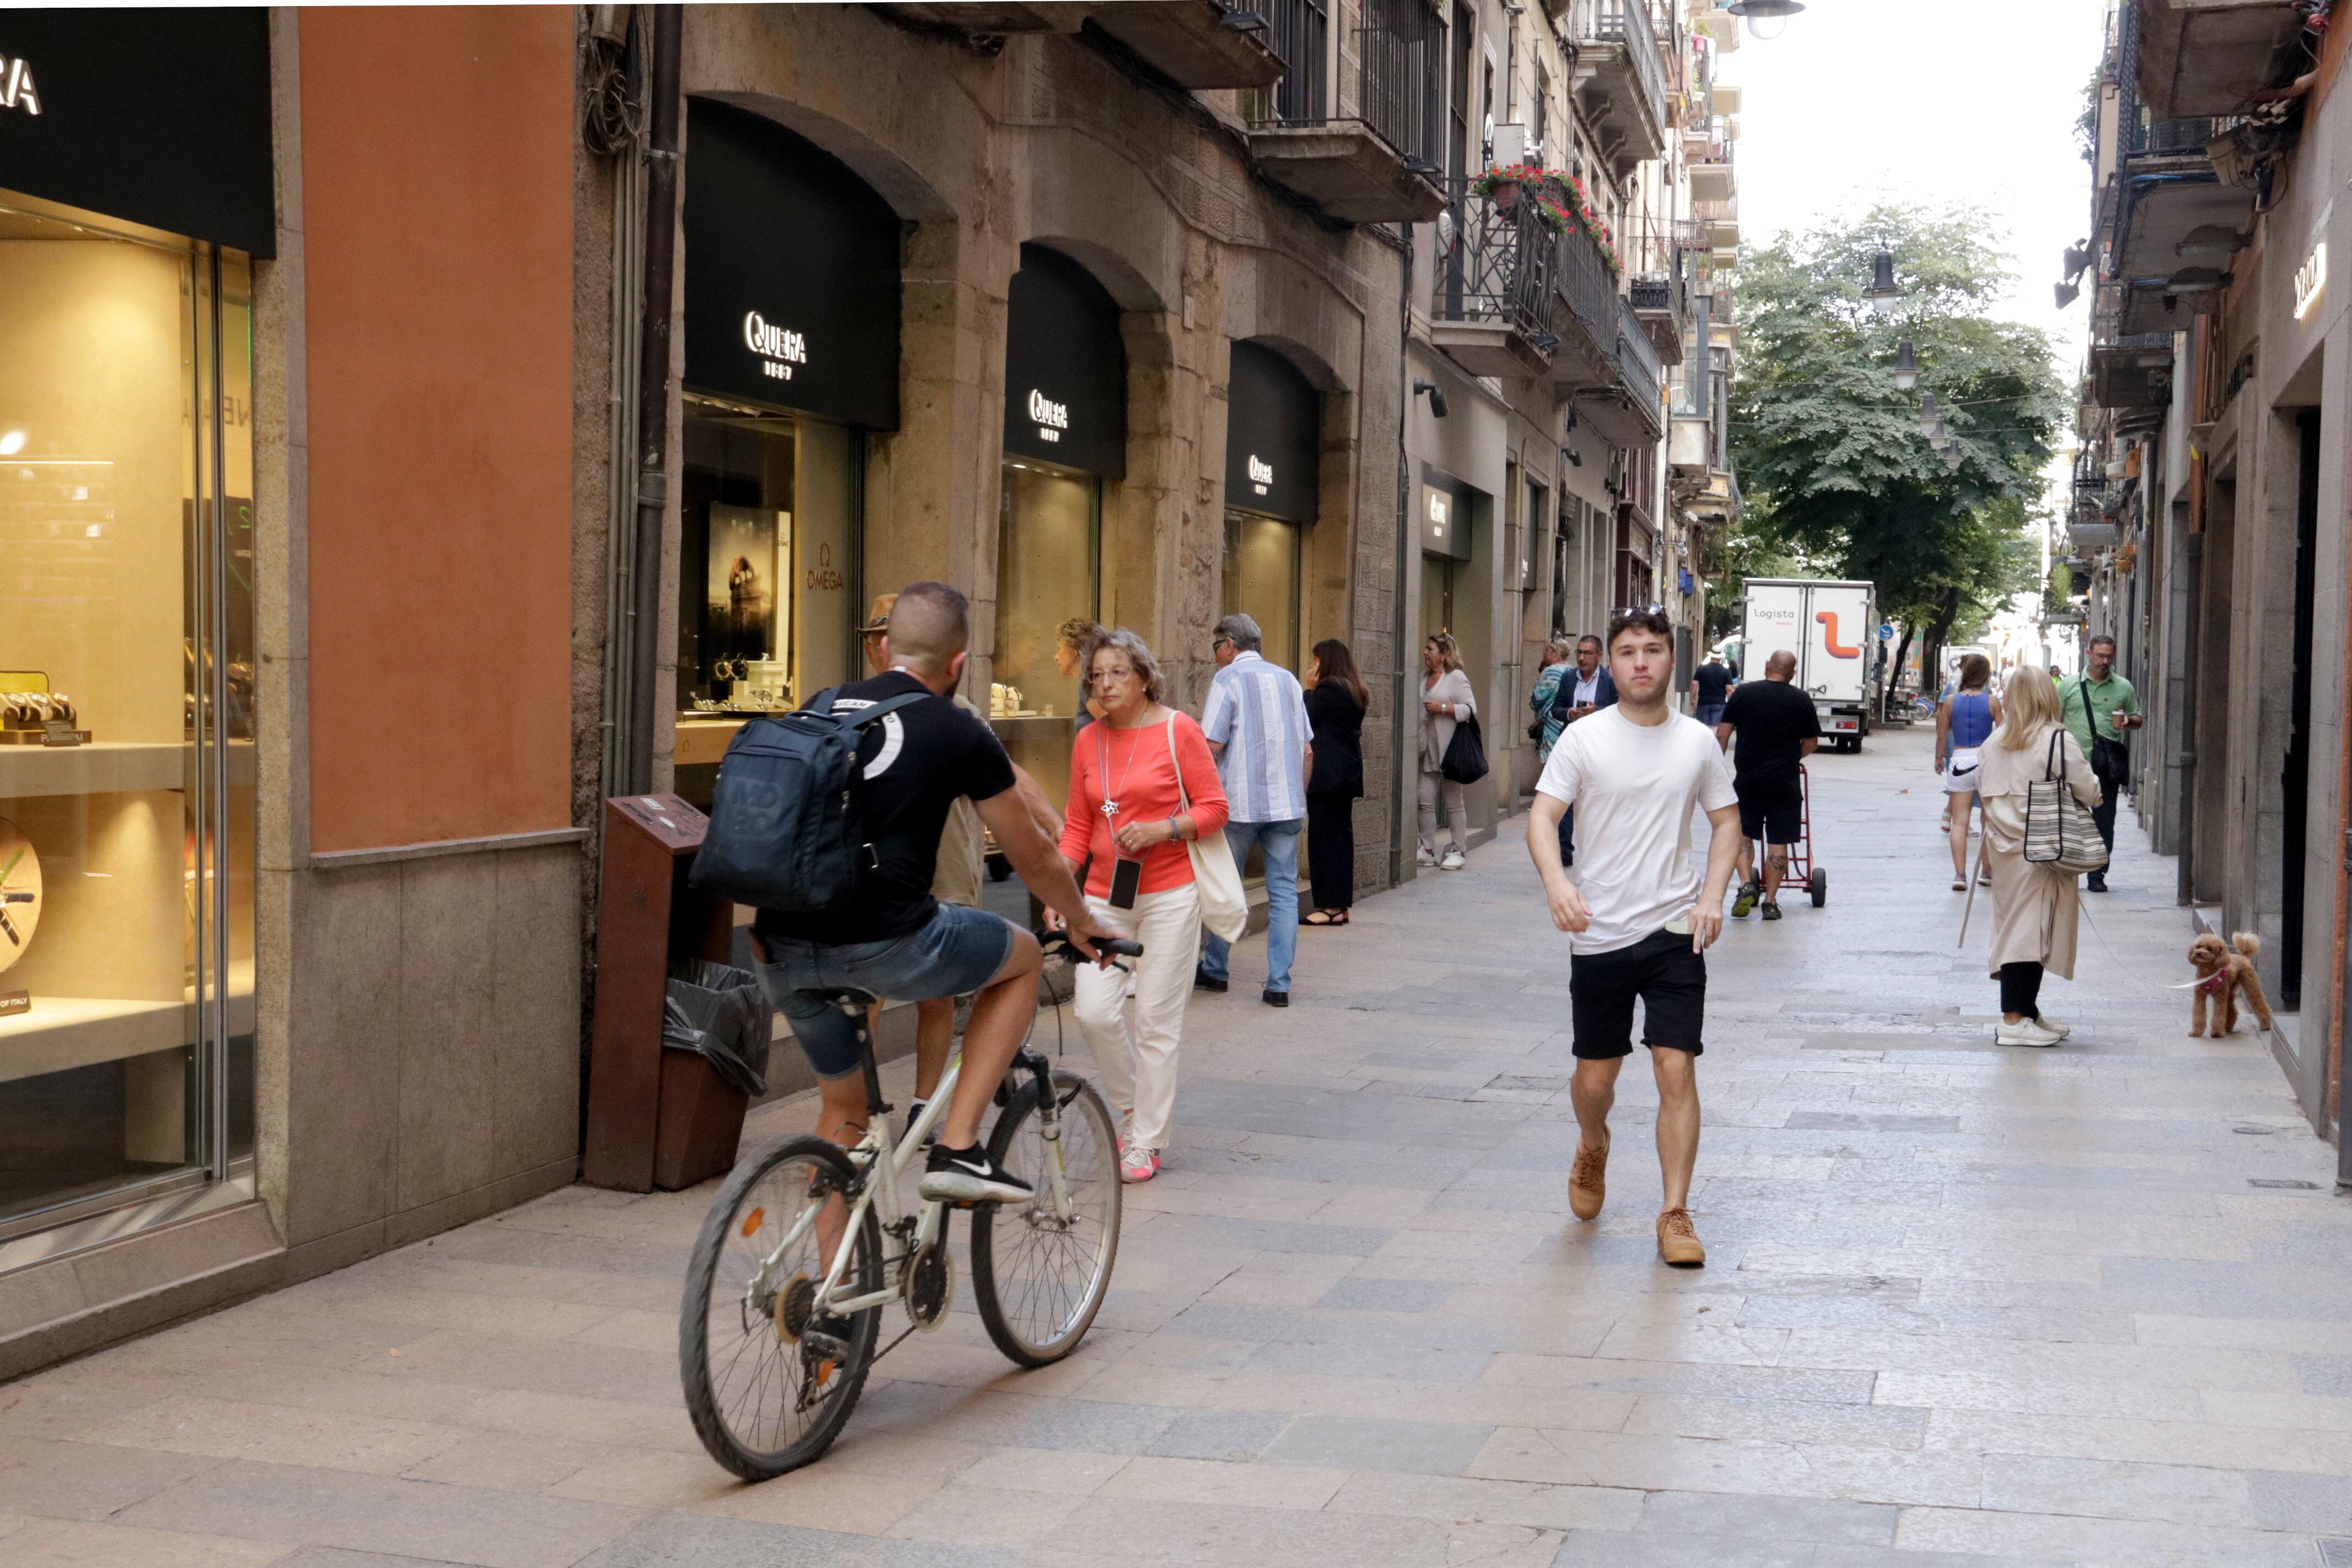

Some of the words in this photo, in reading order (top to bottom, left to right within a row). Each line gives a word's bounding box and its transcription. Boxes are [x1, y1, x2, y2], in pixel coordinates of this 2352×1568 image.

[744, 311, 807, 363] QUERA
[1030, 389, 1068, 428] QUERA
[807, 570, 843, 590] OMEGA
[1754, 609, 1794, 619] logista
[10, 997, 28, 1006] ITALY
